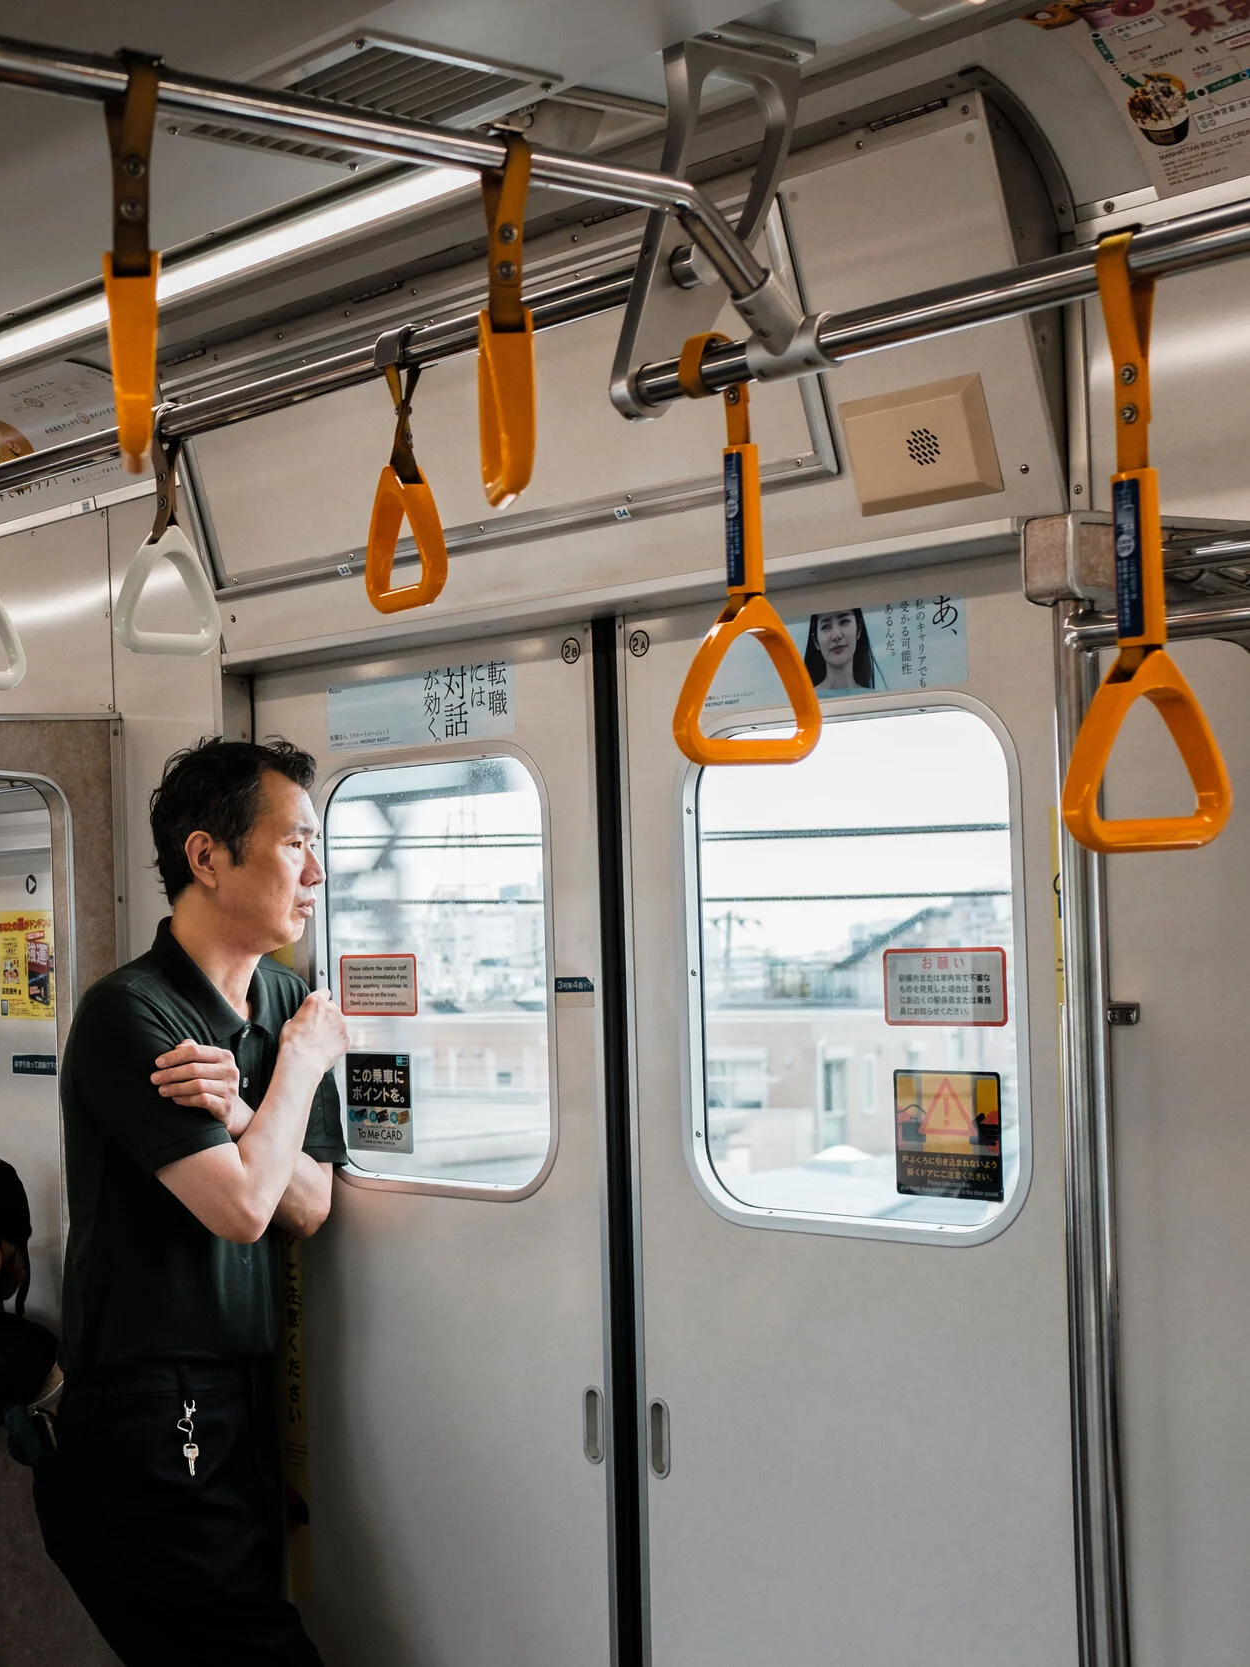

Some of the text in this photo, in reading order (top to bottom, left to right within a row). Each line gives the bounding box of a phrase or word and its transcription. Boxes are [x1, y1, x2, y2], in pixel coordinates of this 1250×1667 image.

[616, 509, 629, 519] 34
[339, 566, 350, 574] 33
[885, 604, 895, 656] あるんだ。
[900, 601, 912, 675] 受かる可能性
[915, 598, 927, 688] 私のキャリアでも
[423, 670, 442, 743] が効く。
[443, 665, 468, 738] 対話
[470, 664, 485, 708] には
[487, 660, 508, 717] 転職
[352, 1068, 404, 1084] この乗車に
[352, 1085, 405, 1103] ポイントを。
[357, 1128, 402, 1141] To Me CARD
